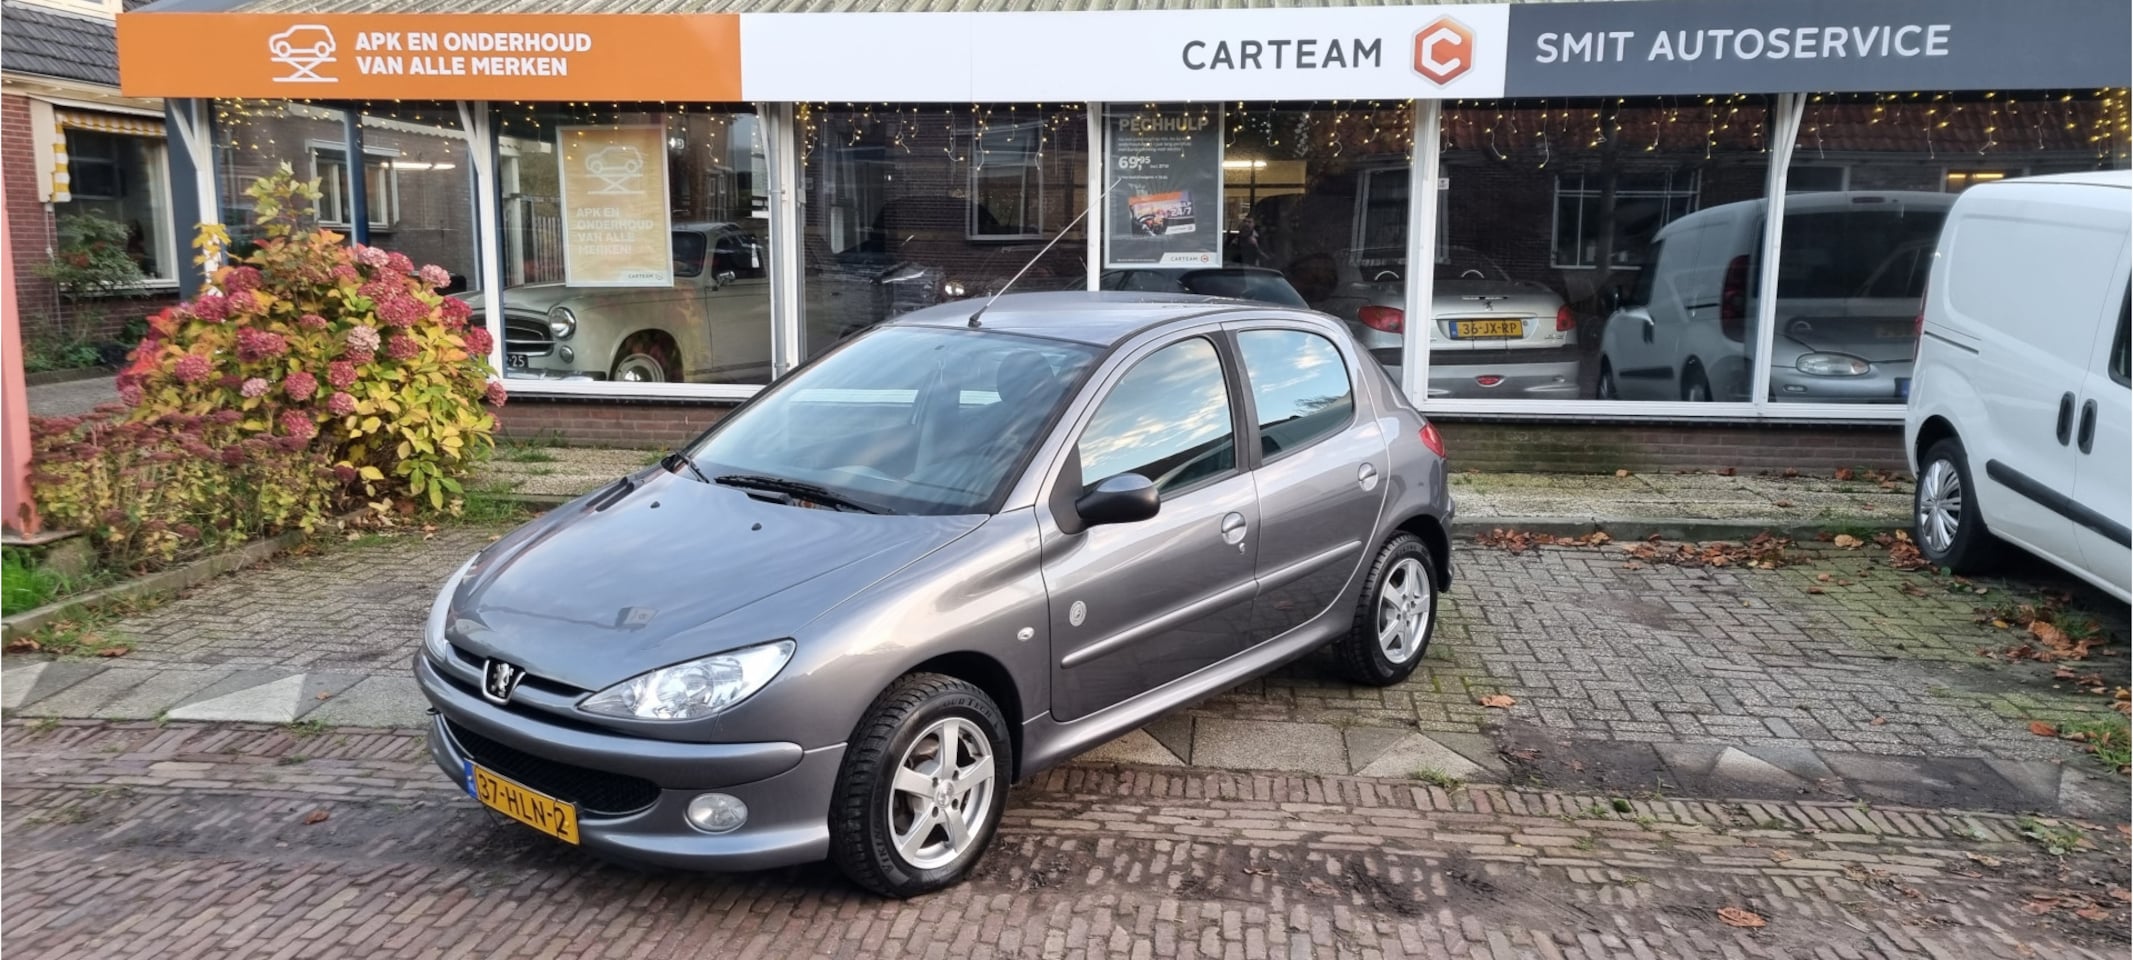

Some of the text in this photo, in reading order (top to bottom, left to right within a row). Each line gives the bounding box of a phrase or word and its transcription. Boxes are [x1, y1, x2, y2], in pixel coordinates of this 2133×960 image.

[355, 32, 592, 52] APK EN ONDERHOUD
[1535, 24, 1951, 64] SMIT AUTOSERVICE
[1182, 38, 1382, 70] CARTEAM
[355, 56, 568, 76] VAN ALLE MERKEN
[1119, 118, 1209, 131] PECHHULP
[576, 208, 620, 218] APK EN
[576, 219, 654, 230] ONDERHOUD
[577, 232, 635, 242] VAN ALLE
[1463, 322, 1517, 335] 36-JX-RP
[478, 773, 569, 835] 37-HLN-2
